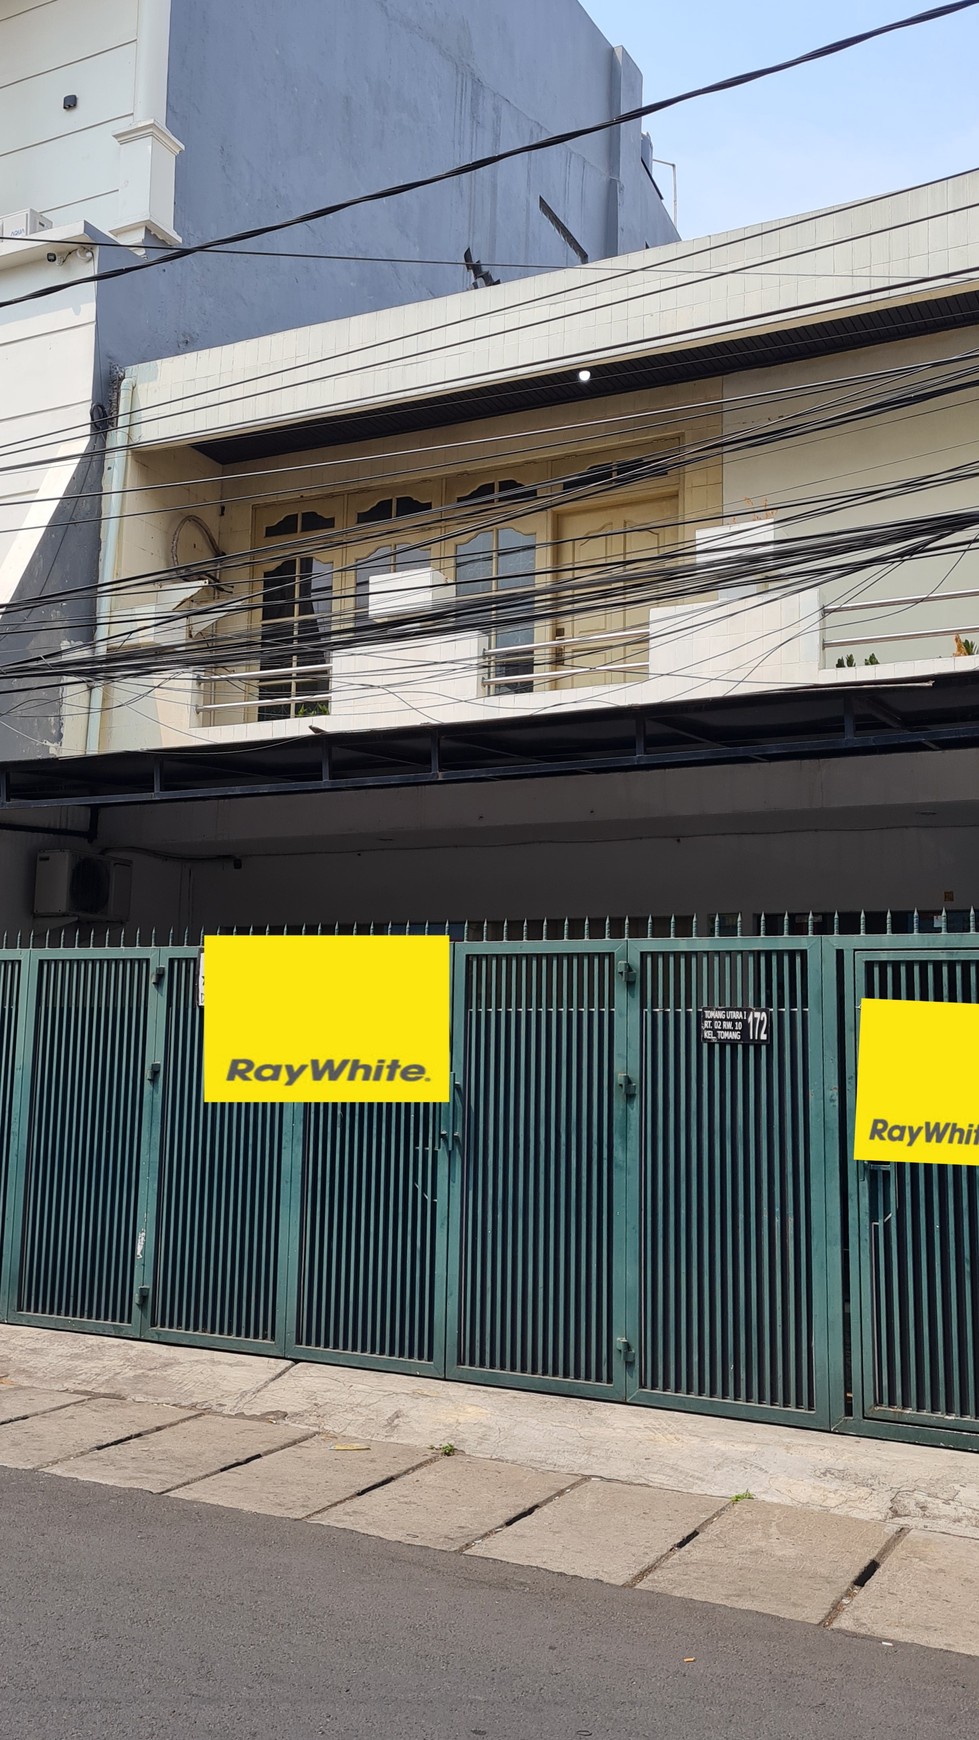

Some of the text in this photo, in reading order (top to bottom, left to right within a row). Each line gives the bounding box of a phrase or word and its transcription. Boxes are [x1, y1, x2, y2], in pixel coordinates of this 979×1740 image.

[704, 1010, 726, 1019] TOMANG
[726, 1011, 743, 1019] UTARA
[704, 1020, 743, 1030] RT. 02 RW. 10
[748, 1011, 767, 1040] 172
[717, 1030, 741, 1040] TOMANG
